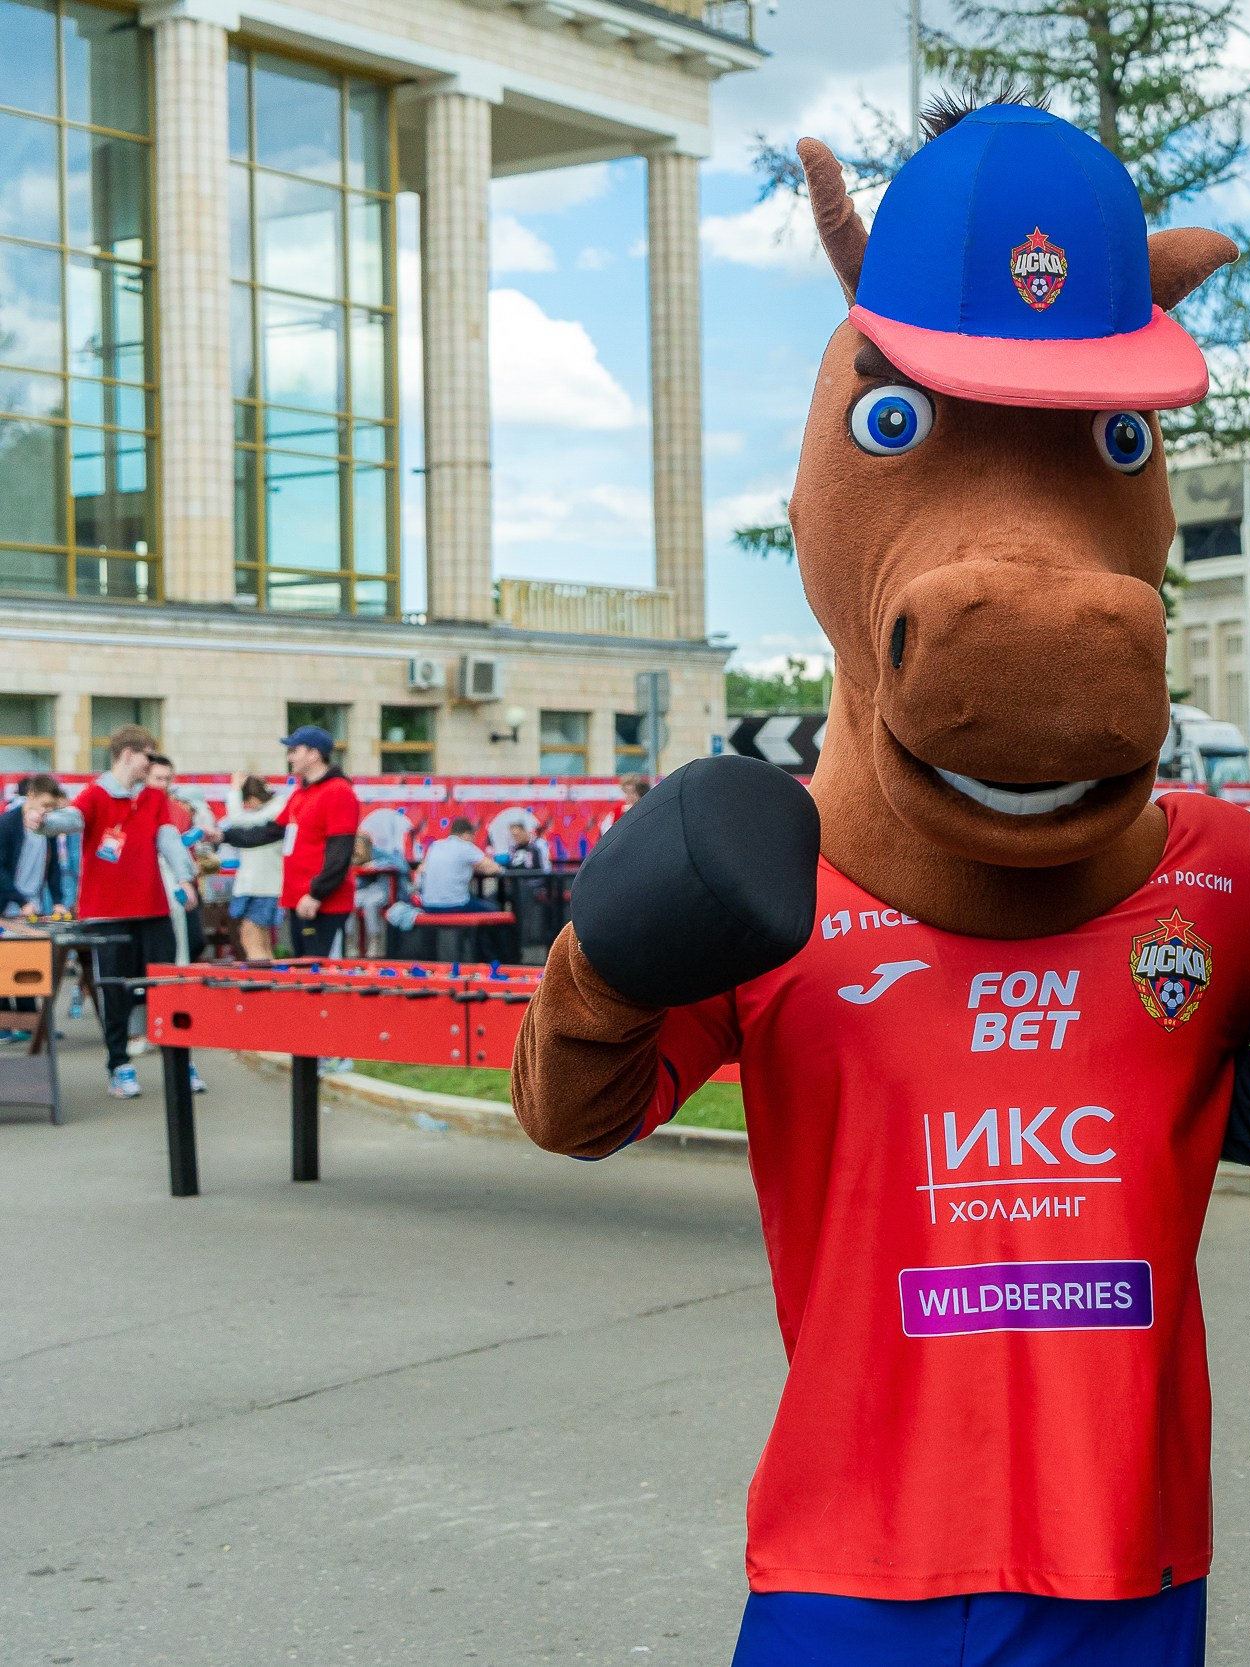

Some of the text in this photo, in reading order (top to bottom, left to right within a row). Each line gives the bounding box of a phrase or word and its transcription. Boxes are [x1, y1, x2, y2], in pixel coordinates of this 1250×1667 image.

[1014, 252, 1064, 276] ЦСКА
[1175, 870, 1233, 894] РОССИИ
[1136, 943, 1207, 982] ЦСКА
[967, 970, 1081, 1009] FON
[970, 1010, 1081, 1052] BET
[943, 1105, 1117, 1170] ИКС
[948, 1196, 1086, 1223] ХОЛДИНГ
[918, 1281, 1133, 1316] WILDBERRIES
